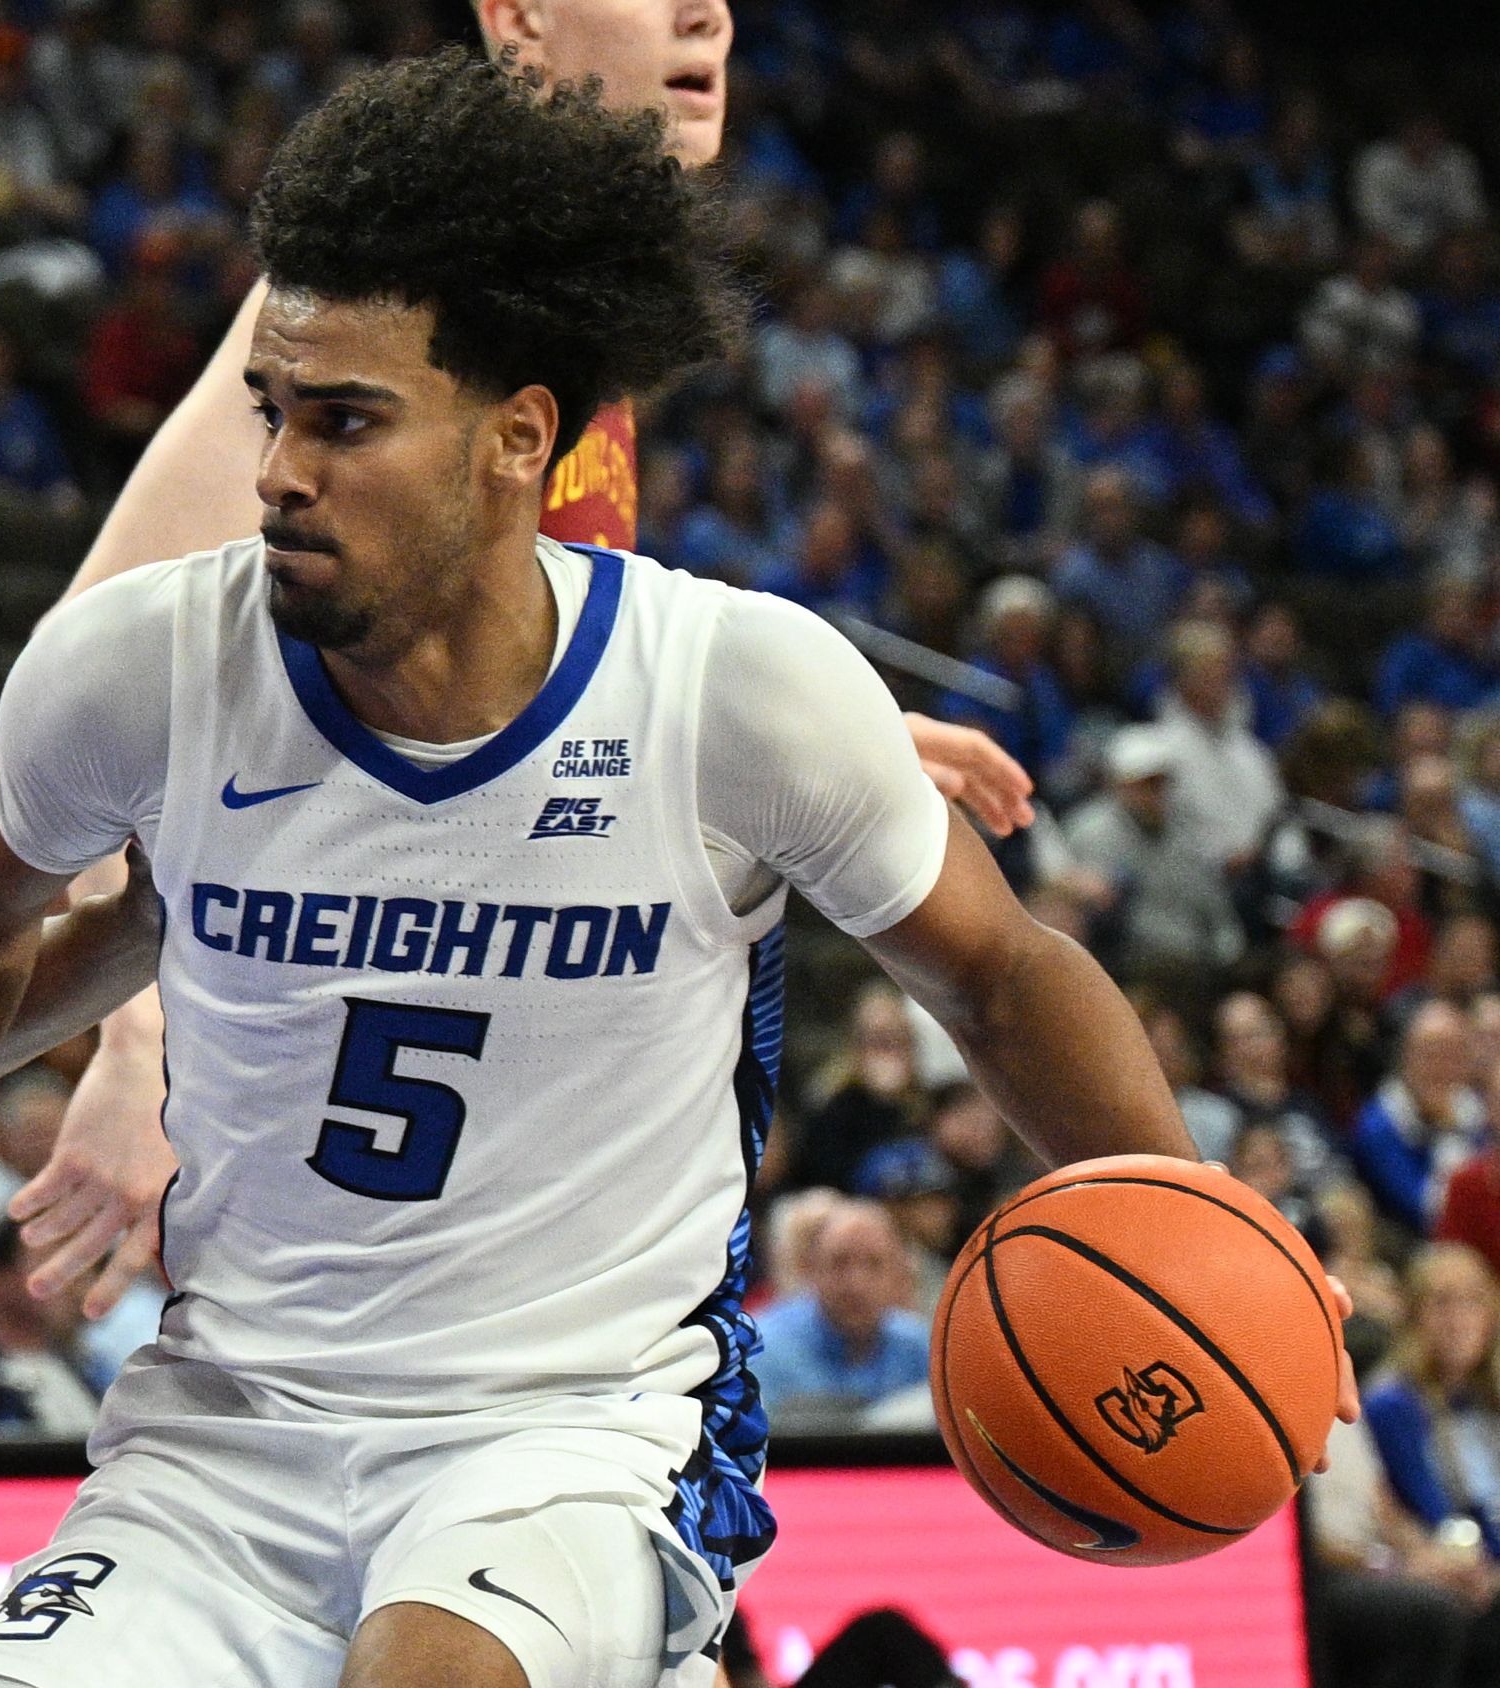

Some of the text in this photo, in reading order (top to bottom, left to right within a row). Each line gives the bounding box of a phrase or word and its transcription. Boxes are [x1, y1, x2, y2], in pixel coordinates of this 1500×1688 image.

[560, 739, 629, 758] BE THE
[552, 758, 632, 778] CHANGE
[542, 798, 602, 814] BIG
[533, 815, 617, 831] EAST
[192, 883, 672, 979] CREIGHTON
[304, 996, 492, 1201] 5
